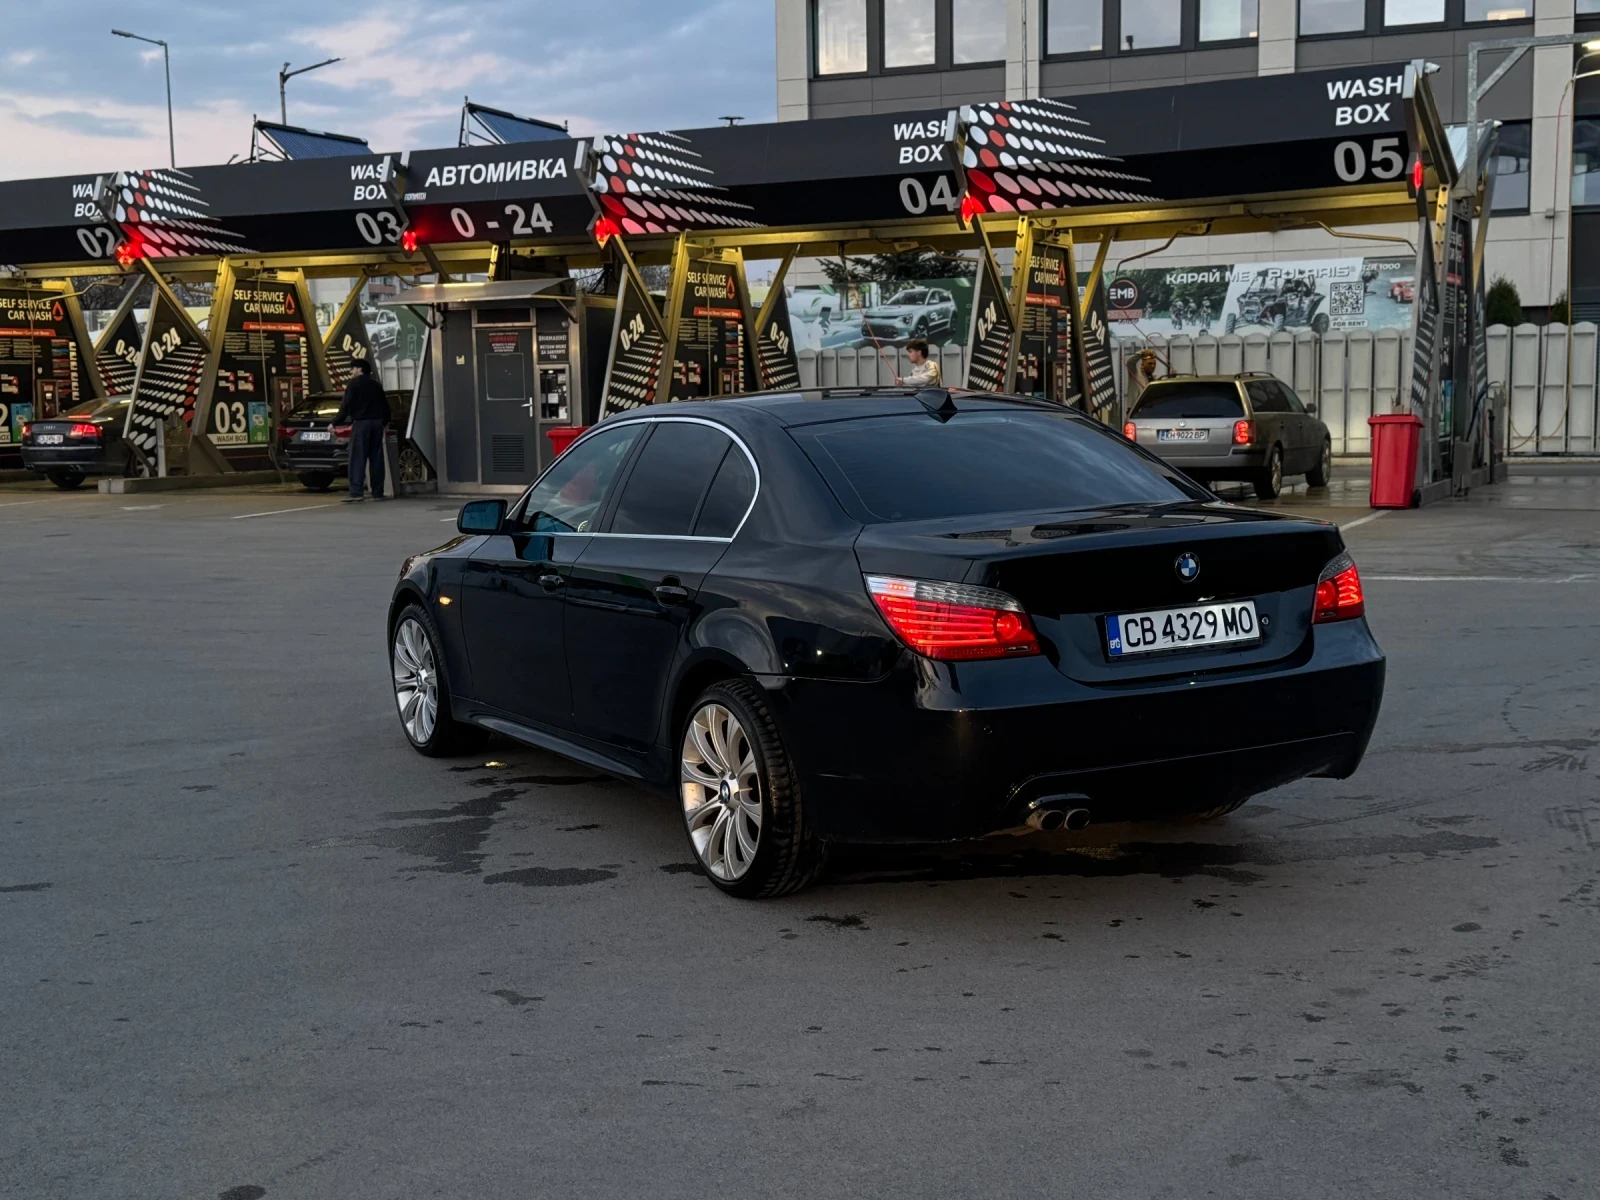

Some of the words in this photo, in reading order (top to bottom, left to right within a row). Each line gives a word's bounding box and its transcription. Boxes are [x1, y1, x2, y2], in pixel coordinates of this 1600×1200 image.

[1327, 75, 1403, 100] WASH
[1335, 102, 1391, 126] BOX
[899, 144, 944, 164] BOX
[1333, 138, 1404, 182] 05
[351, 164, 396, 180] WAS
[424, 158, 568, 187] АВТОМИВКА
[354, 184, 388, 201] BOX
[899, 175, 957, 215] 04
[355, 211, 401, 245] 03
[450, 207, 476, 238] 0
[505, 203, 554, 235] 24
[76, 227, 115, 258] 02
[687, 271, 701, 284] SELF
[702, 273, 727, 286] SERVICE
[1034, 271, 1044, 284] CAR
[1044, 272, 1059, 286] WASH
[1165, 268, 1221, 285] КАРАЙ
[1379, 262, 1401, 271] 1000
[18, 299, 51, 310] SERVICE
[234, 289, 252, 300] SELF
[253, 291, 285, 302] SERVICE
[694, 285, 708, 297] CAR
[708, 287, 727, 299] WASH
[1109, 287, 1135, 300] EMB
[8, 310, 26, 320] CAR
[27, 310, 52, 321] WASH
[244, 303, 260, 313] CAR
[261, 304, 285, 314] WASH
[620, 313, 645, 351] 0-24
[977, 301, 997, 342] 0-24
[1090, 310, 1106, 346] 0-24
[151, 327, 181, 361] 0-24
[342, 333, 367, 360] 0-24
[770, 322, 790, 355] 0-24
[115, 339, 141, 366] 0-24
[215, 402, 246, 433] 03
[1176, 431, 1194, 439] 9022
[1194, 431, 1205, 439] BP
[1124, 616, 1157, 648] CB
[1162, 610, 1218, 643] 4329
[1221, 606, 1254, 637] MO
